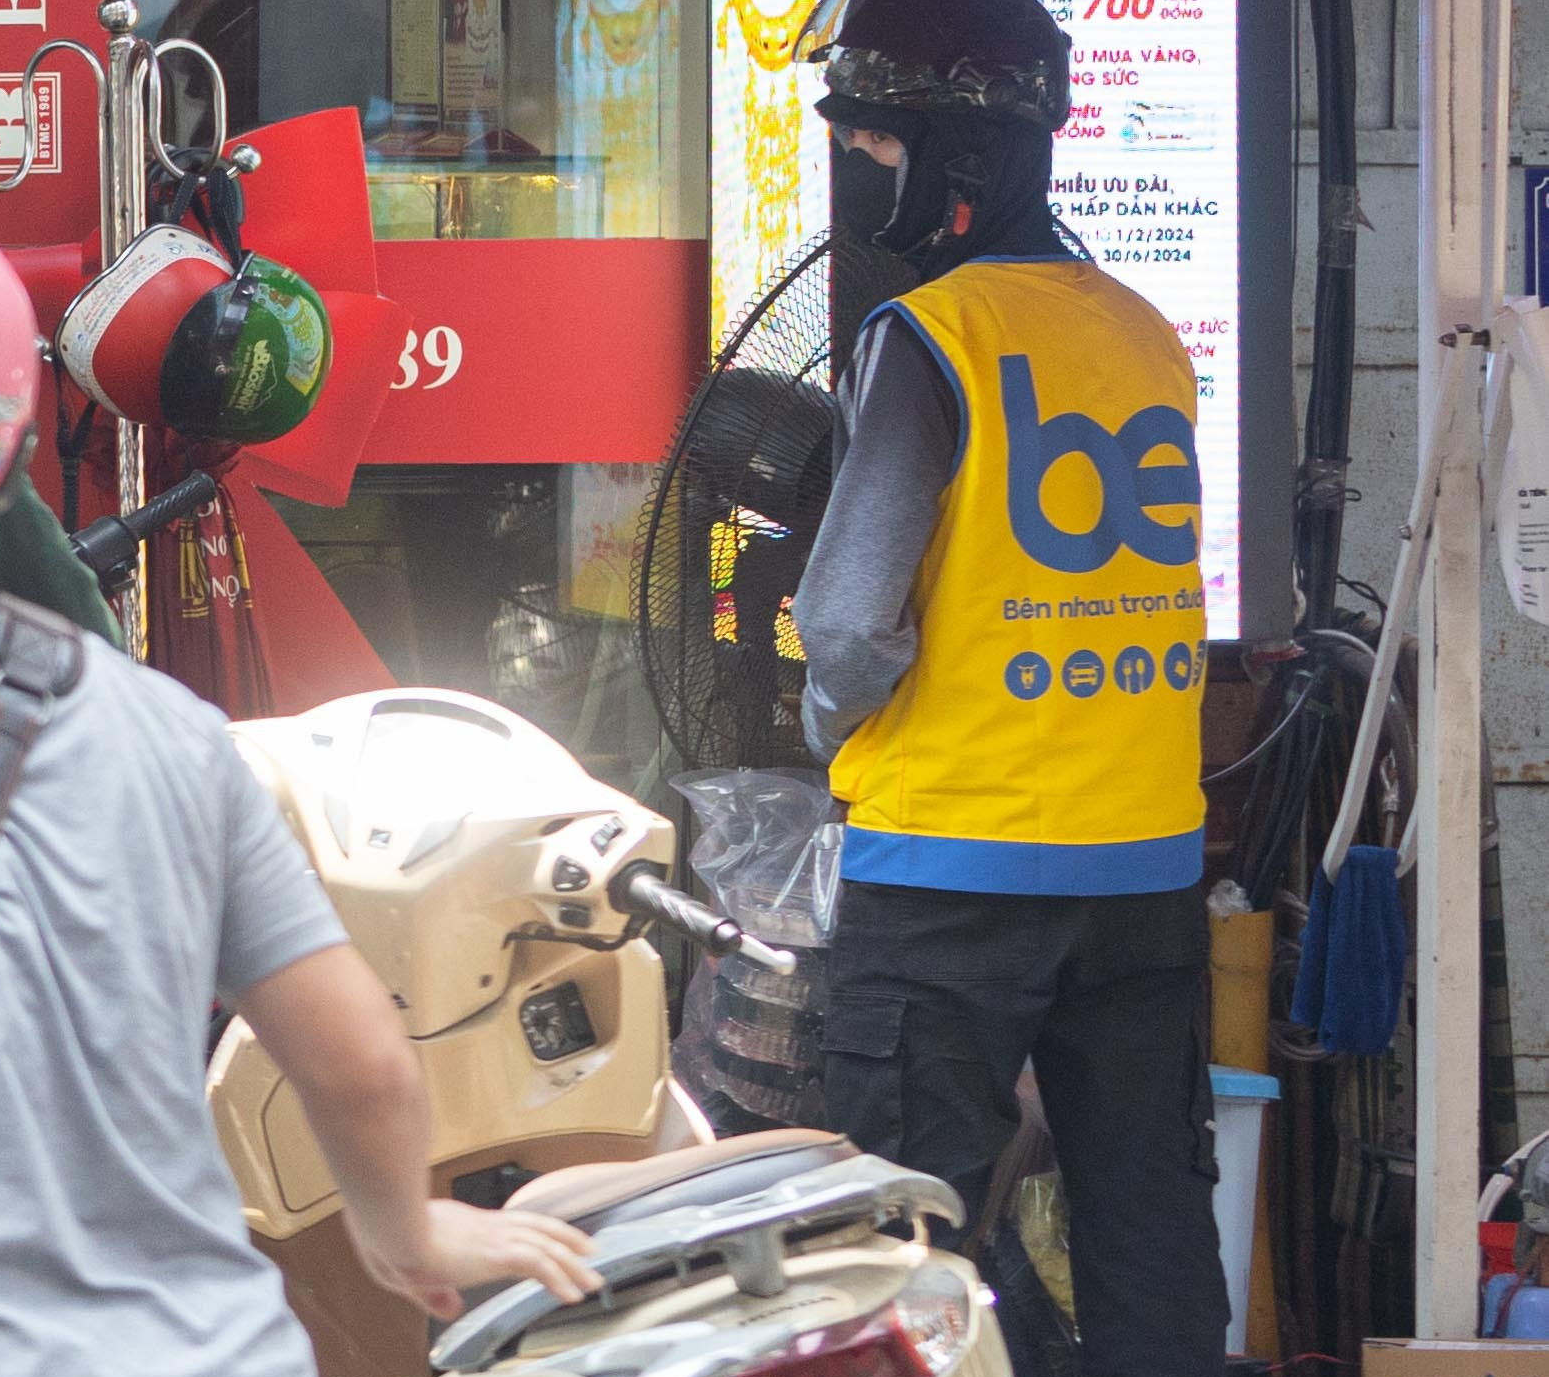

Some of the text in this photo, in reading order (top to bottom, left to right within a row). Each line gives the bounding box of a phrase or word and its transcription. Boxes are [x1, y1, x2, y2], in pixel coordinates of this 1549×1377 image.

[39, 86, 50, 158] BTMC 1989
[1165, 199, 1219, 217] KHÁC
[1117, 227, 1194, 242] 1/2/2024
[1103, 248, 1192, 262] 30/6/2024
[999, 353, 1202, 573] be
[1003, 597, 1052, 622] Bên
[1057, 593, 1117, 619] nhau
[1119, 590, 1170, 621] trọn
